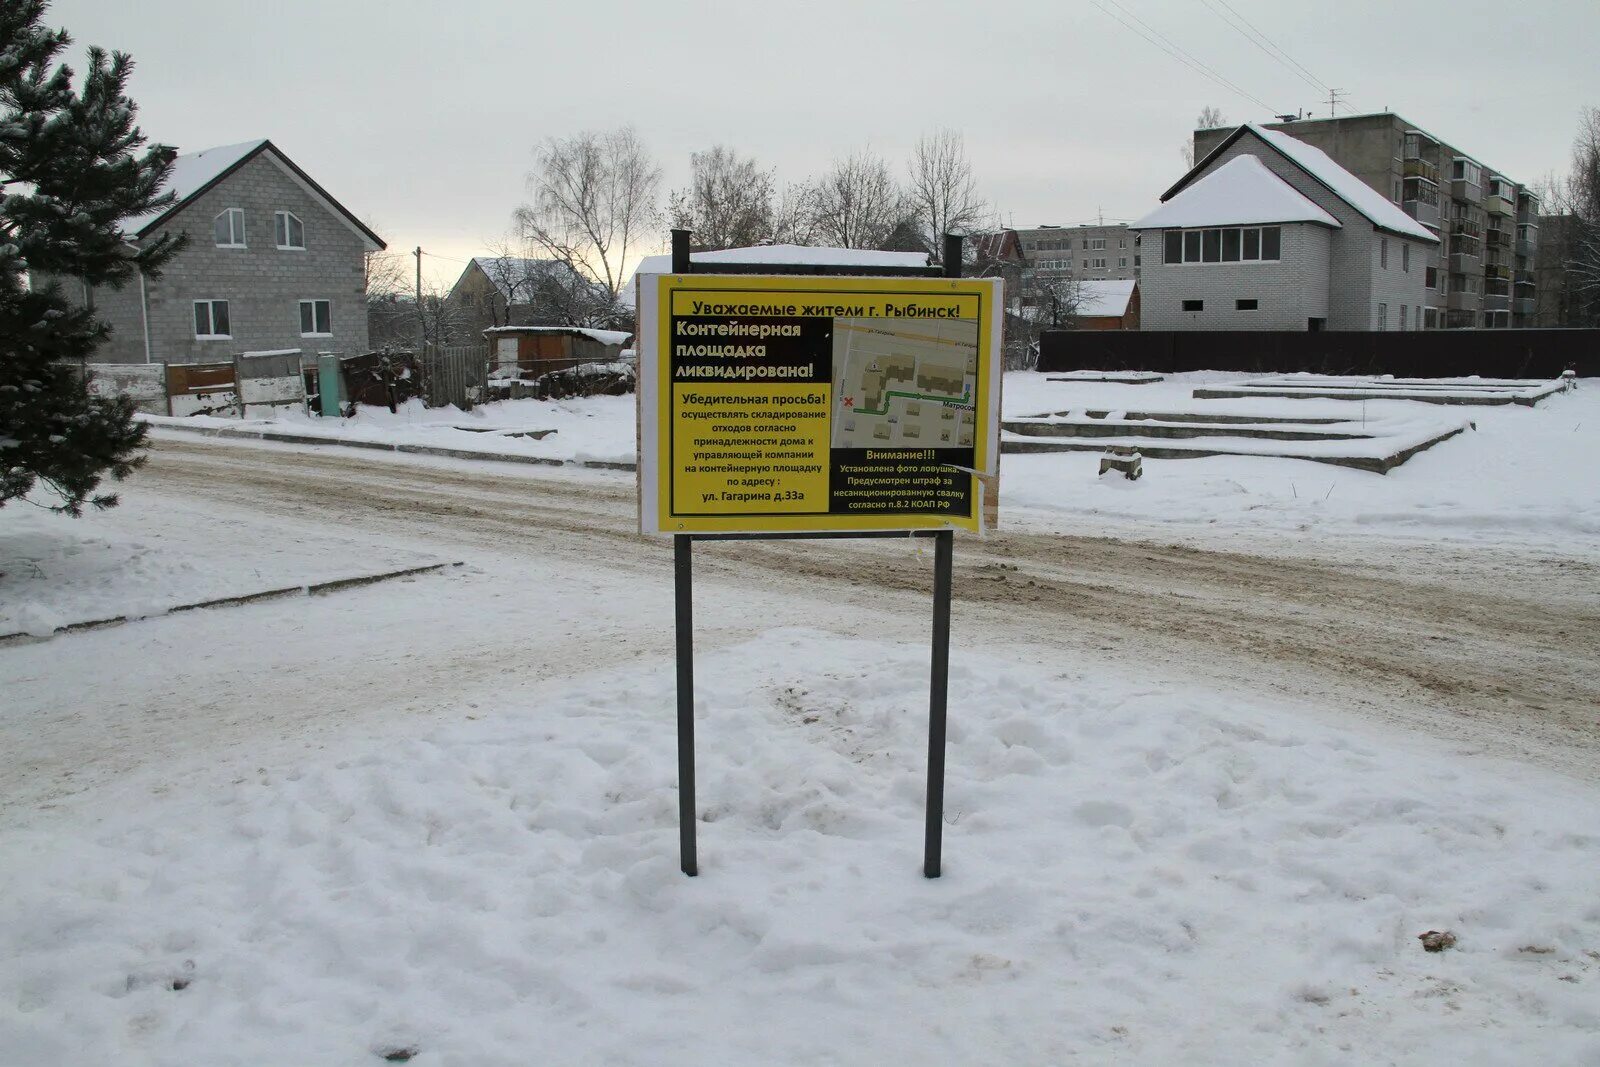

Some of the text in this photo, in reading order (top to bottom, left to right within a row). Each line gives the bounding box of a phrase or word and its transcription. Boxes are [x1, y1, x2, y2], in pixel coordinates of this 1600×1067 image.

[692, 301, 960, 318] Уважаемые жители г. Рыбинск!
[676, 320, 801, 340] Контейнерная
[676, 344, 766, 358] площадка
[676, 362, 814, 380] ликвидирована!
[682, 393, 826, 407] Убедительная просьба!
[681, 410, 826, 420] осуществлять складирование
[712, 424, 797, 433] отходов согласно
[694, 438, 778, 447] принадлежности
[780, 438, 806, 446] дома
[693, 450, 814, 461] управляющей компании
[866, 450, 936, 460] Внимание!!!
[684, 463, 822, 474] на контейнерную площадку
[840, 464, 960, 474] Установлена фото ловушка.
[741, 478, 775, 488] адресу
[847, 477, 953, 486] Предусмотрен штраф за
[702, 490, 805, 502] ул. Гагарина д.33а
[834, 490, 965, 500] несанкционированную свалку
[848, 500, 950, 510] согласно п.8.2 КОАП РФ
